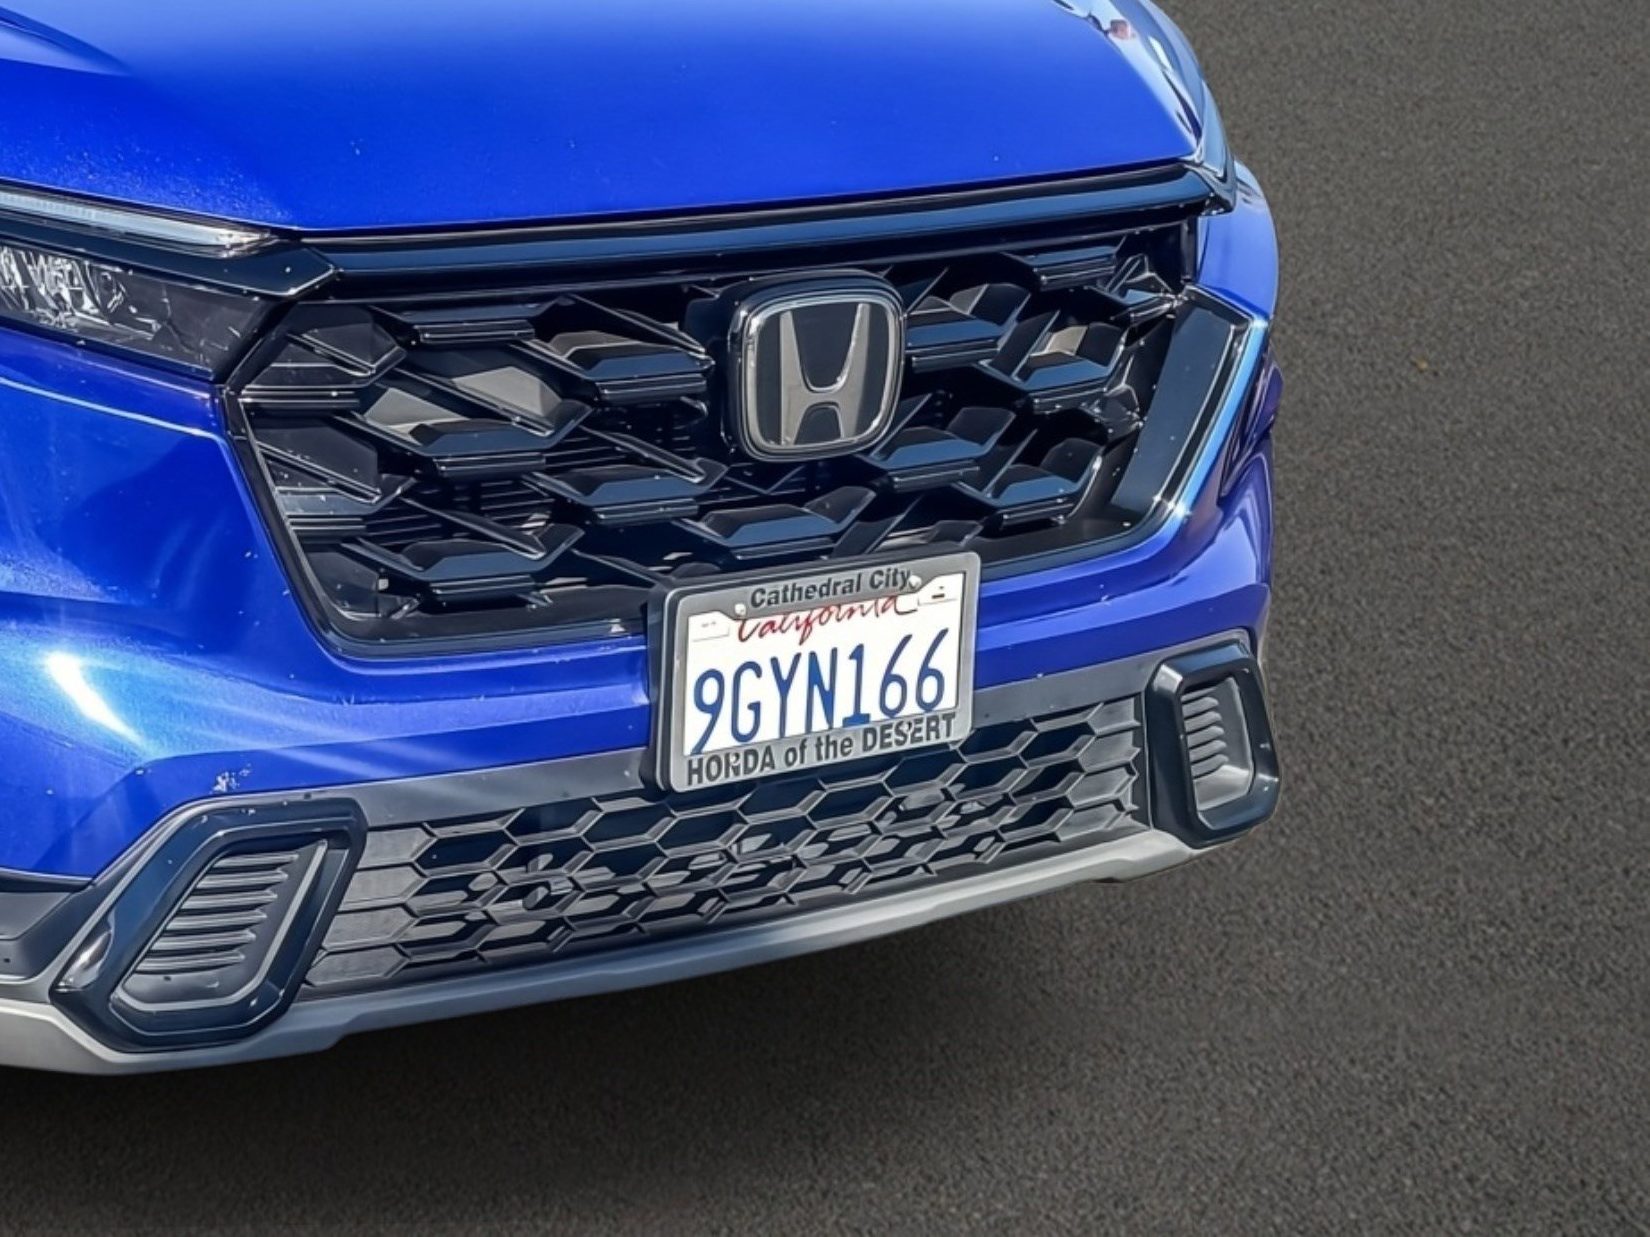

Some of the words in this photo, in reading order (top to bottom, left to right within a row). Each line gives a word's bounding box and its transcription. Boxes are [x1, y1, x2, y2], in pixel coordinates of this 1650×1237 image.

[750, 573, 861, 608] Cathedral
[868, 566, 912, 590] City
[690, 627, 949, 755] 9GYN166
[686, 745, 775, 786] HONDA
[783, 738, 807, 765] of
[813, 729, 853, 760] the
[861, 712, 956, 752] DESERT
